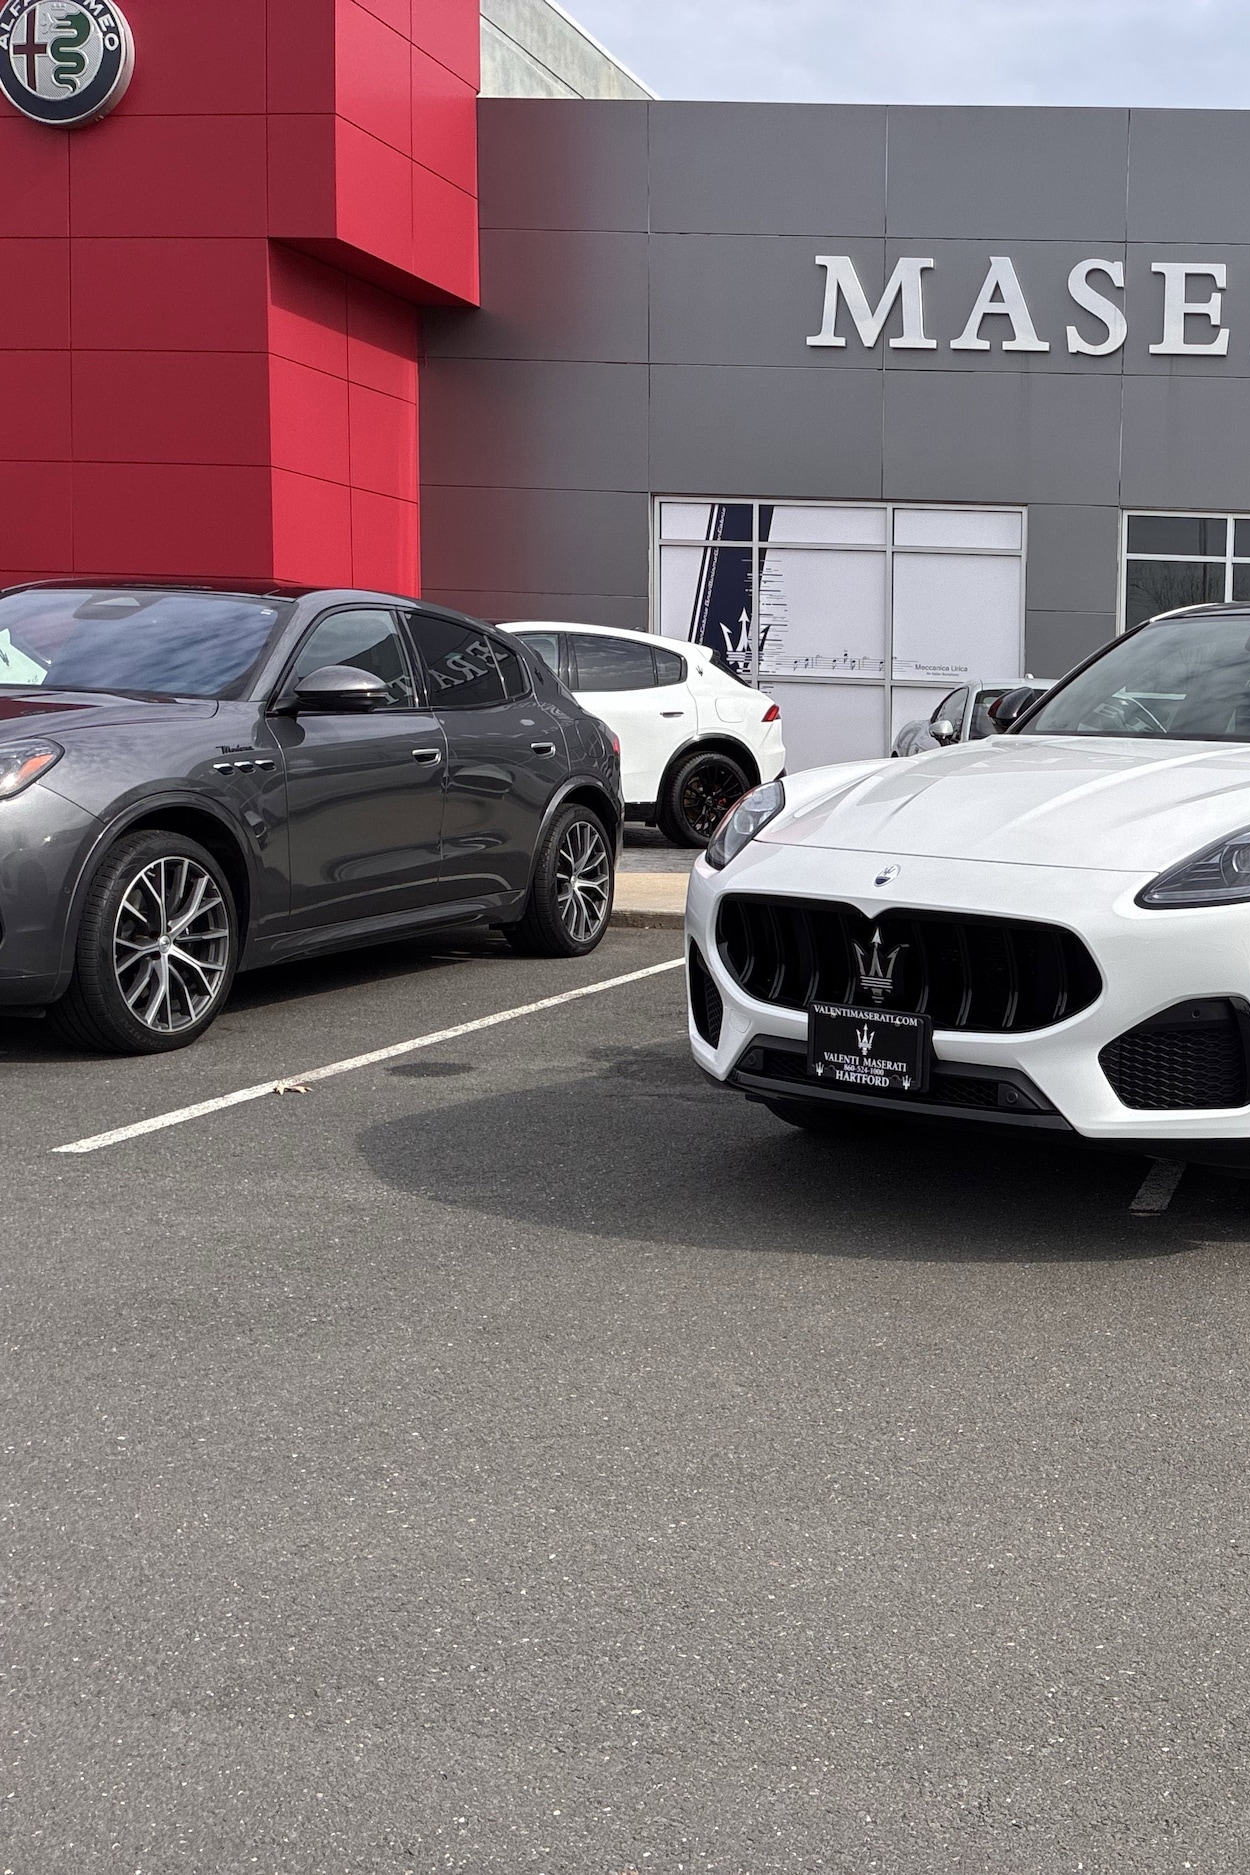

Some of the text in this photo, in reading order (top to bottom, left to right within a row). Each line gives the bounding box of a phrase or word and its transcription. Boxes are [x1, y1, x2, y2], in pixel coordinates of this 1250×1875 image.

[83, 0, 120, 51] MEO
[915, 663, 950, 672] Meccanica
[813, 1004, 919, 1027] VALENTIMASERATI.COM
[823, 1051, 908, 1073] VALENTI MASERATI
[843, 1063, 885, 1076] 860-524-1000
[835, 1069, 890, 1088] HARTFORD
